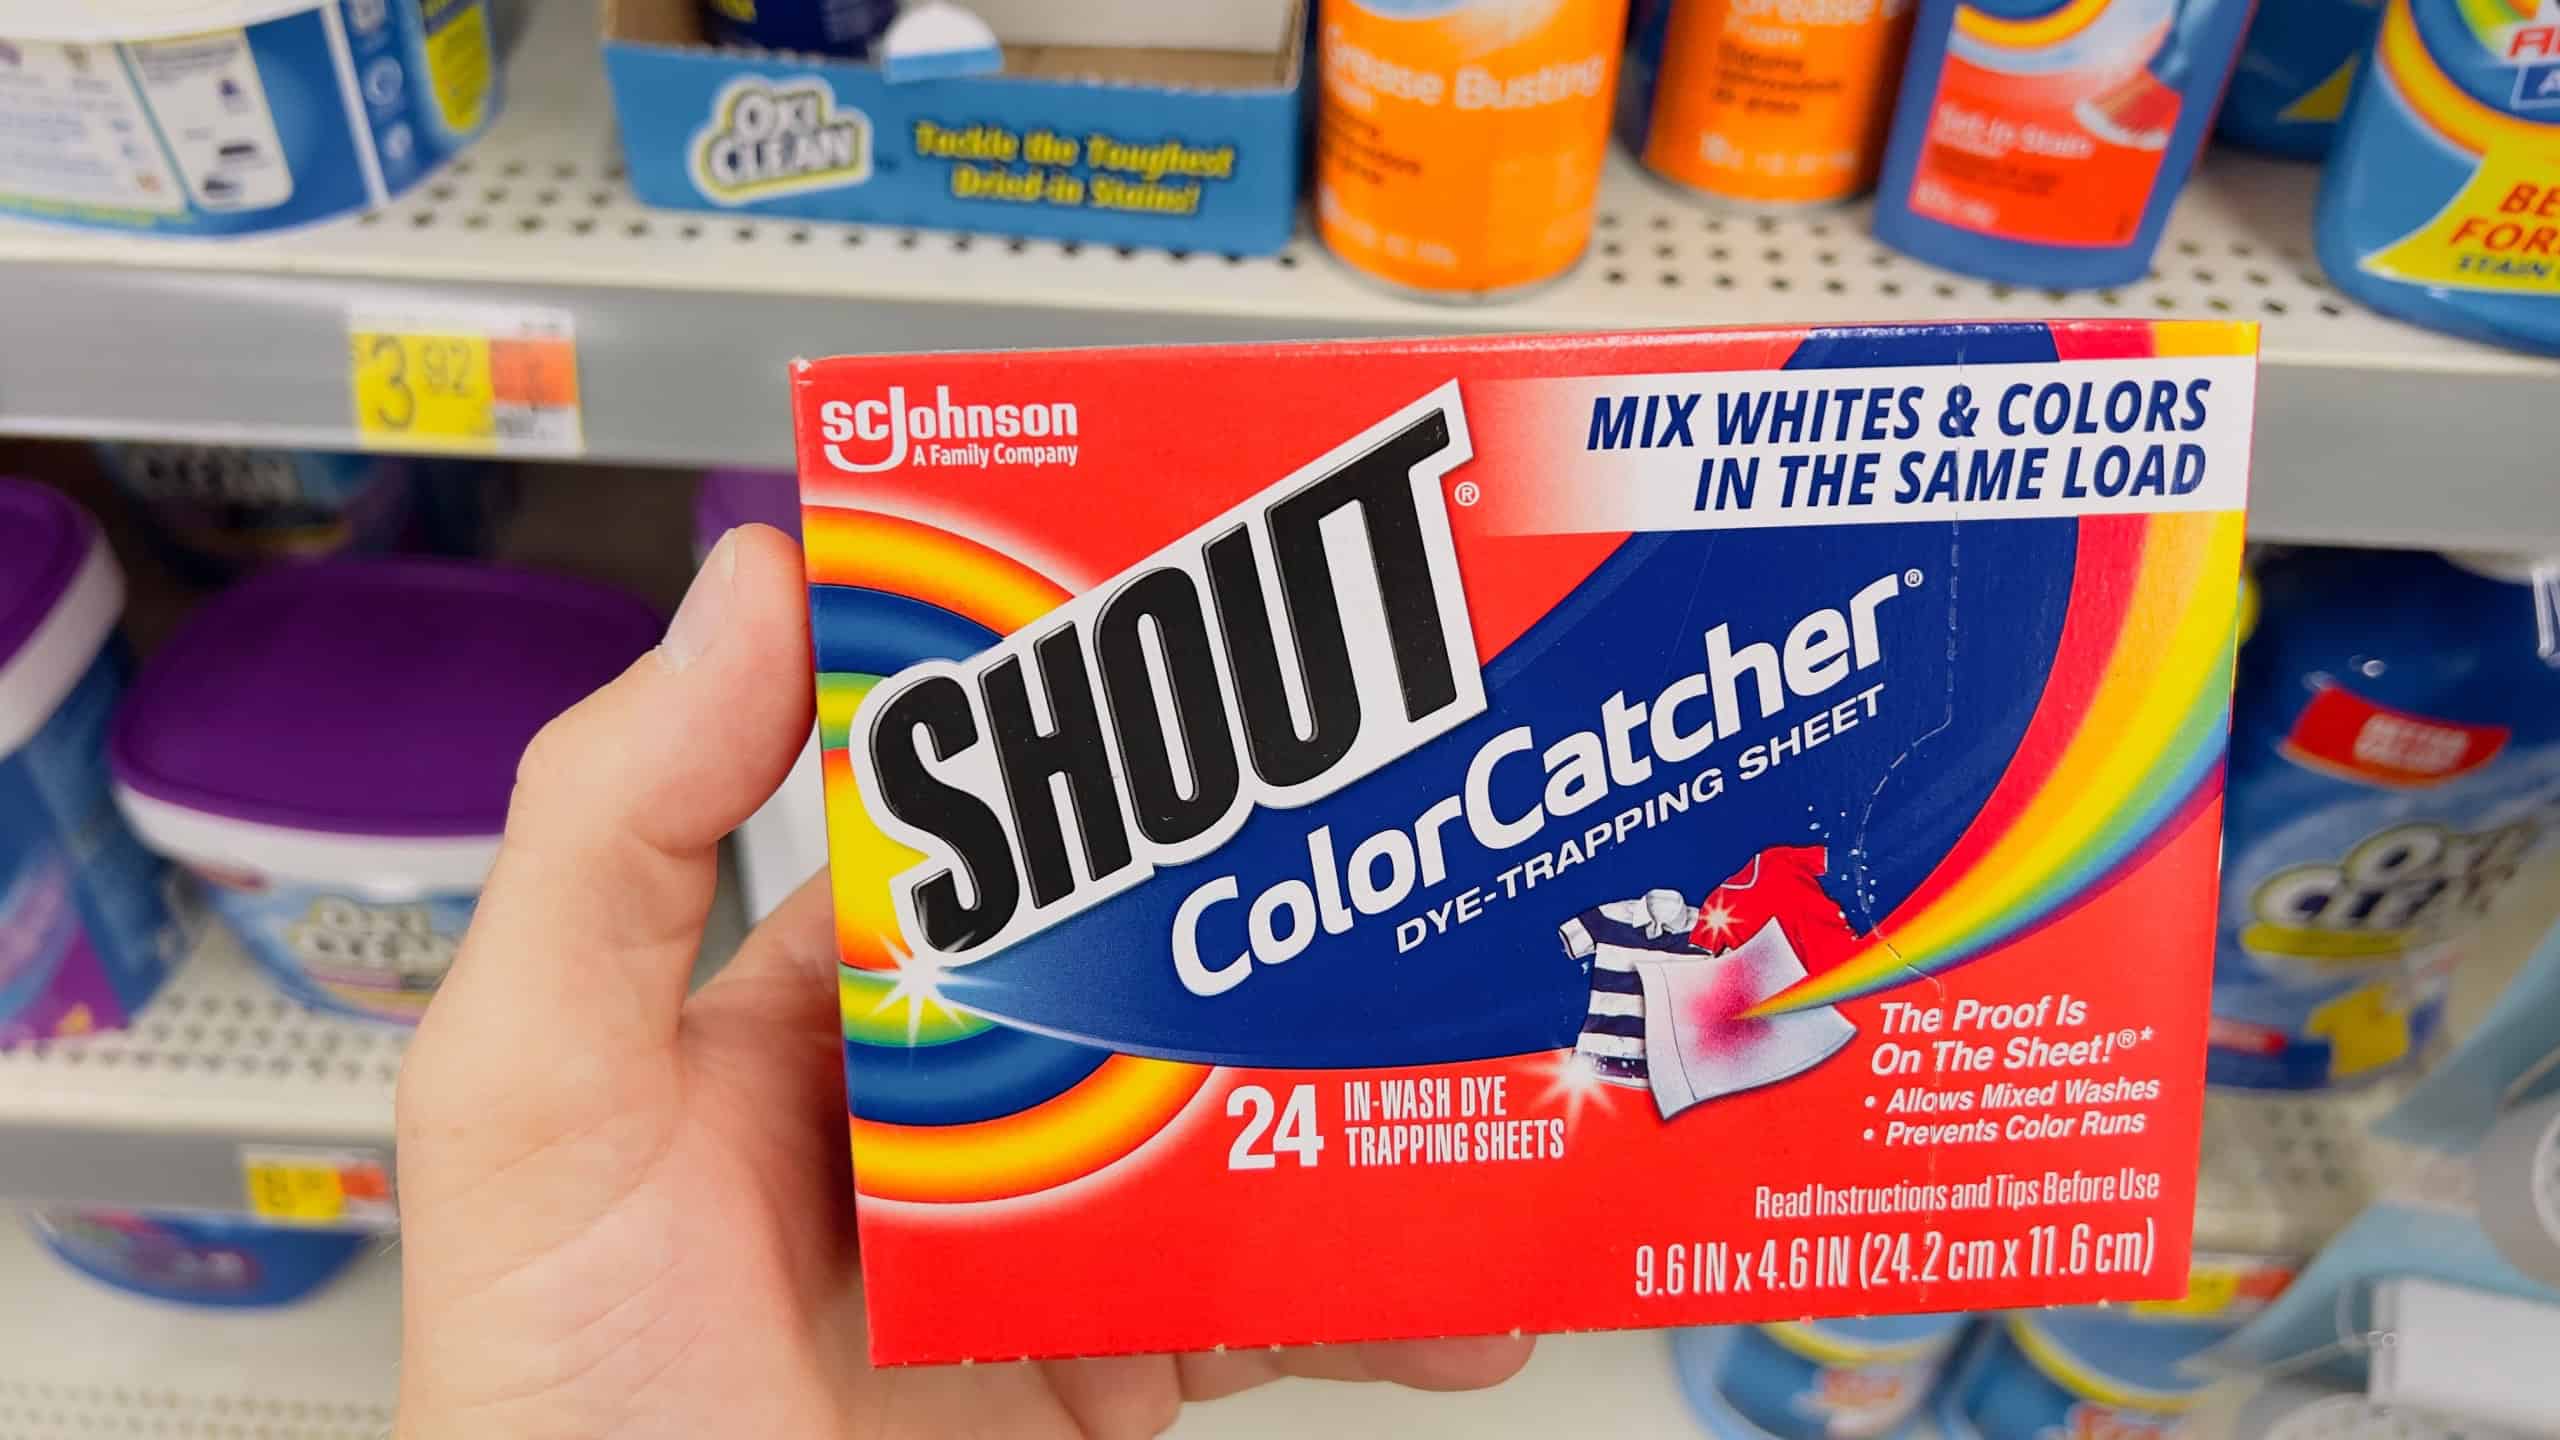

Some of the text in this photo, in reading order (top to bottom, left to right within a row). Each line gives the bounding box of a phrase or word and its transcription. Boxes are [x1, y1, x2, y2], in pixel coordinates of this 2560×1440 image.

[915, 121, 1235, 180] Tackle the Toughest
[2450, 218, 2560, 254] FOR
[1586, 378, 2212, 451] MIX WHITES & COLORS
[912, 442, 1079, 469] A Family Company
[1693, 443, 2208, 512] IN THE SAME LOAD
[1397, 684, 1885, 954] DYE-TRAPPING SHEET
[1880, 995, 2088, 1034] The Proof Is
[1871, 1042, 1922, 1076] On
[1932, 1040, 1994, 1073] The
[1343, 1075, 1507, 1122] IN-WASH DYE
[1885, 1076, 2161, 1114] Allows Mixed Washes
[1225, 1083, 1325, 1171] 24
[1345, 1117, 1566, 1168] TRAPPING SHEETS
[1885, 1110, 2146, 1147] Prevents Color Runs
[1754, 1167, 2161, 1220] Read Instructions and Tips Before Use
[1635, 1215, 2157, 1297] 9.6 IN x 4.6 IN (24.2 cm x 11.6 cm)
